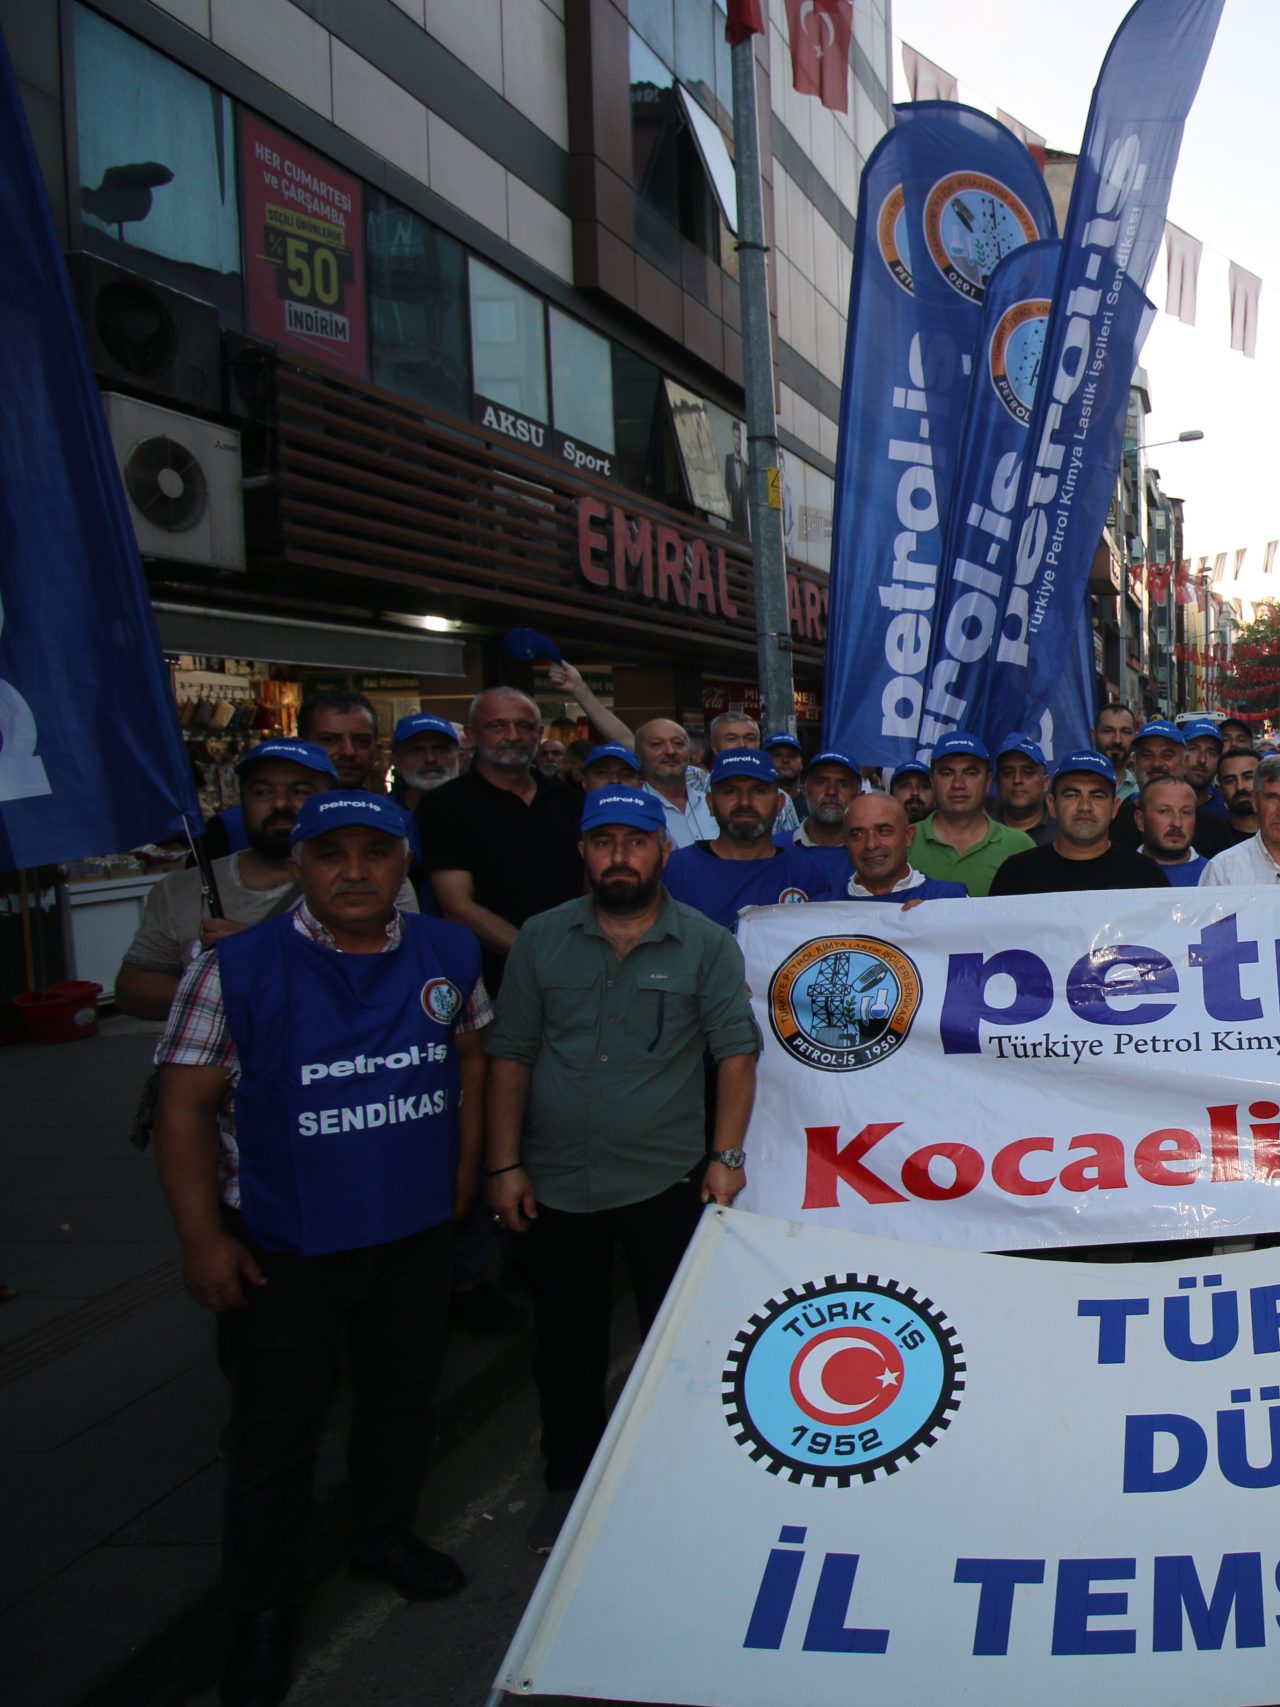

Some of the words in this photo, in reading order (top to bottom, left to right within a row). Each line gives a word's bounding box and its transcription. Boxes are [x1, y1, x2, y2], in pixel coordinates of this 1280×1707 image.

[255, 141, 281, 171] HER
[284, 159, 353, 213] CUMARTESİ
[263, 171, 280, 189] ve
[281, 179, 346, 229] ÇARŞAMBA
[288, 303, 347, 341] İNDİRİM
[1045, 510, 1069, 567] Petrol
[1059, 446, 1084, 507] Kimya
[1073, 381, 1098, 441] Lastik
[1106, 206, 1140, 306] Sendikası
[482, 405, 545, 448] AKSU
[562, 440, 612, 477] Sport
[577, 495, 738, 620] EMRAL
[787, 573, 828, 641] AR
[783, 952, 815, 981] PETROL
[301, 1042, 448, 1086] petrol-iş
[793, 1036, 856, 1067] PETROL-İŞ
[865, 1033, 897, 1060] 1950
[988, 1032, 1104, 1065] Türkiye
[1112, 1026, 1201, 1057] Petrol
[790, 1423, 884, 1456] 1952
[742, 1524, 891, 1655] İL
